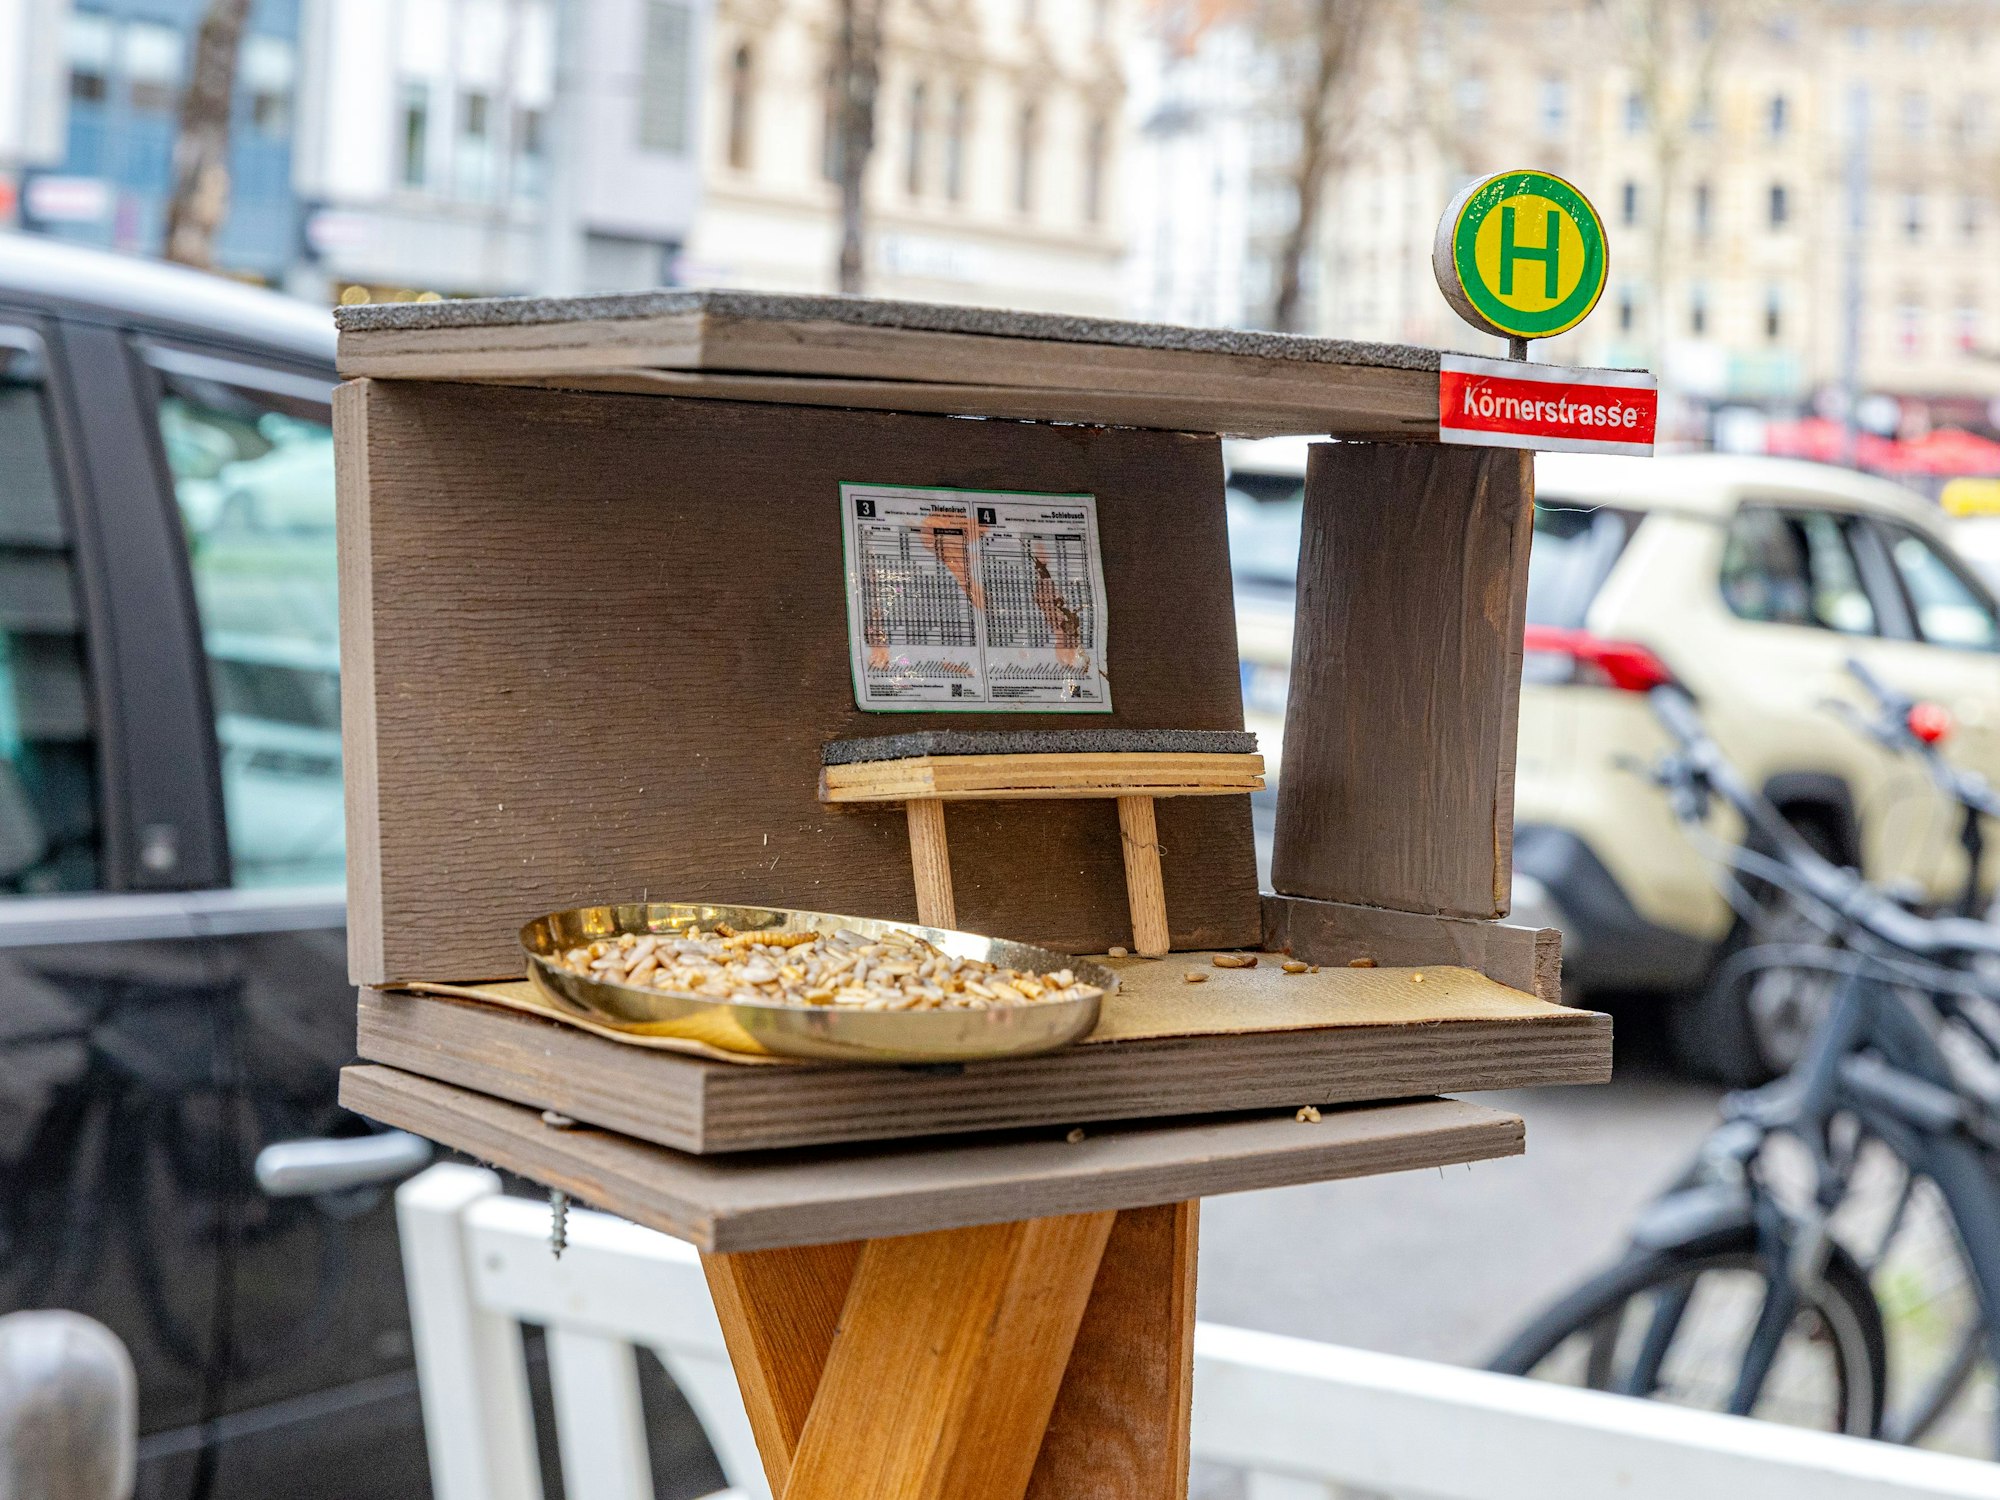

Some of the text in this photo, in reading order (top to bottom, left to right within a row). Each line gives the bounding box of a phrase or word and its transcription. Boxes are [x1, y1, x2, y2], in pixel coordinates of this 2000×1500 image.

[1499, 206, 1560, 300] H
[1463, 385, 1638, 428] Körnerstrasse
[862, 502, 871, 516] 3
[983, 510, 991, 523] 4
